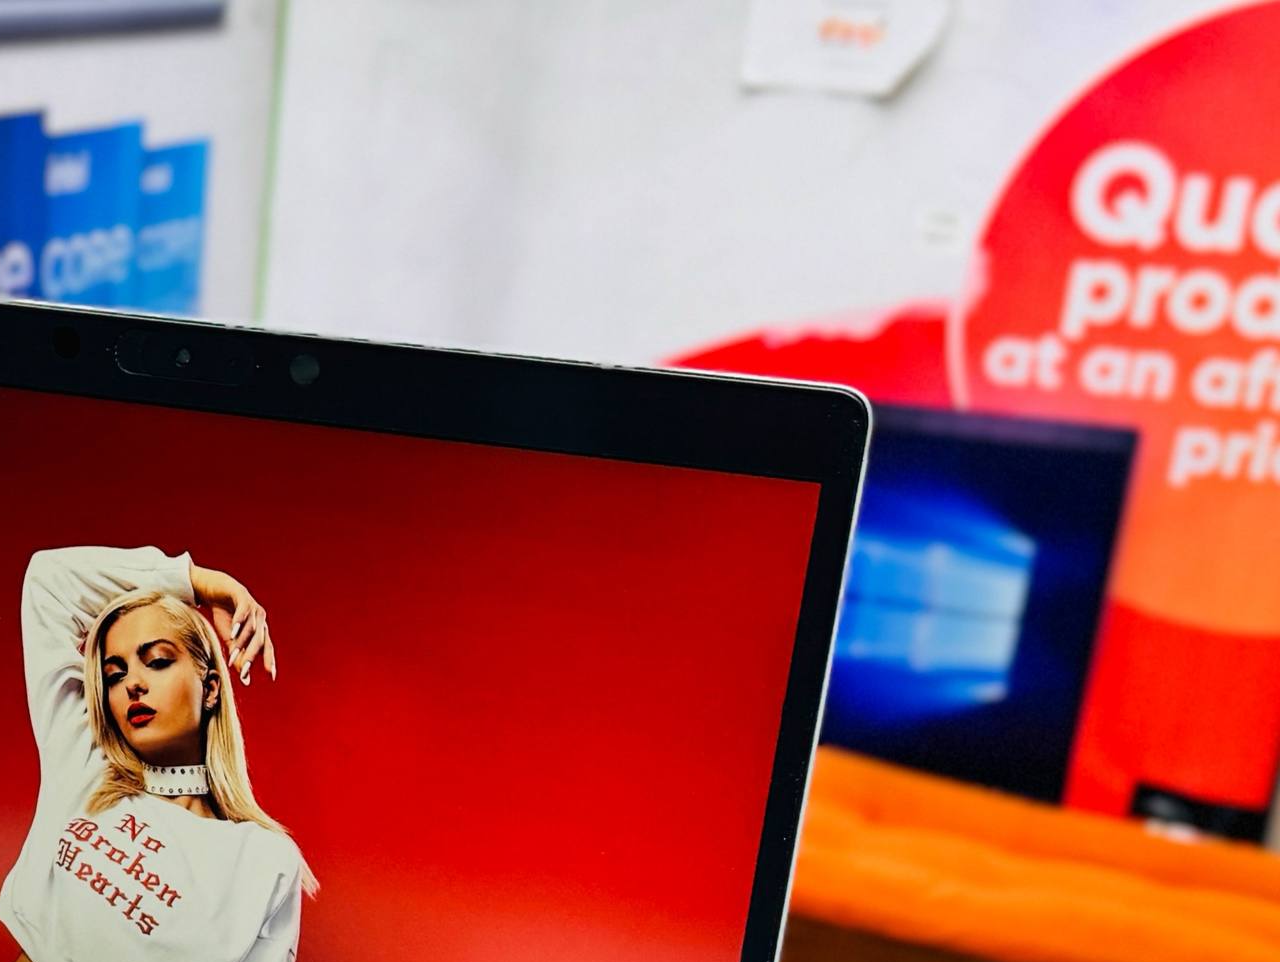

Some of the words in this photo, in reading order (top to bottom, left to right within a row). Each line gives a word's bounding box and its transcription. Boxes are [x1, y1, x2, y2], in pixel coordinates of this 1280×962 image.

[982, 331, 1067, 390] at
[1079, 344, 1176, 400] an
[1166, 420, 1280, 490] pri
[65, 817, 181, 908] Broken
[114, 813, 166, 853] No
[56, 838, 159, 936] Hearts
